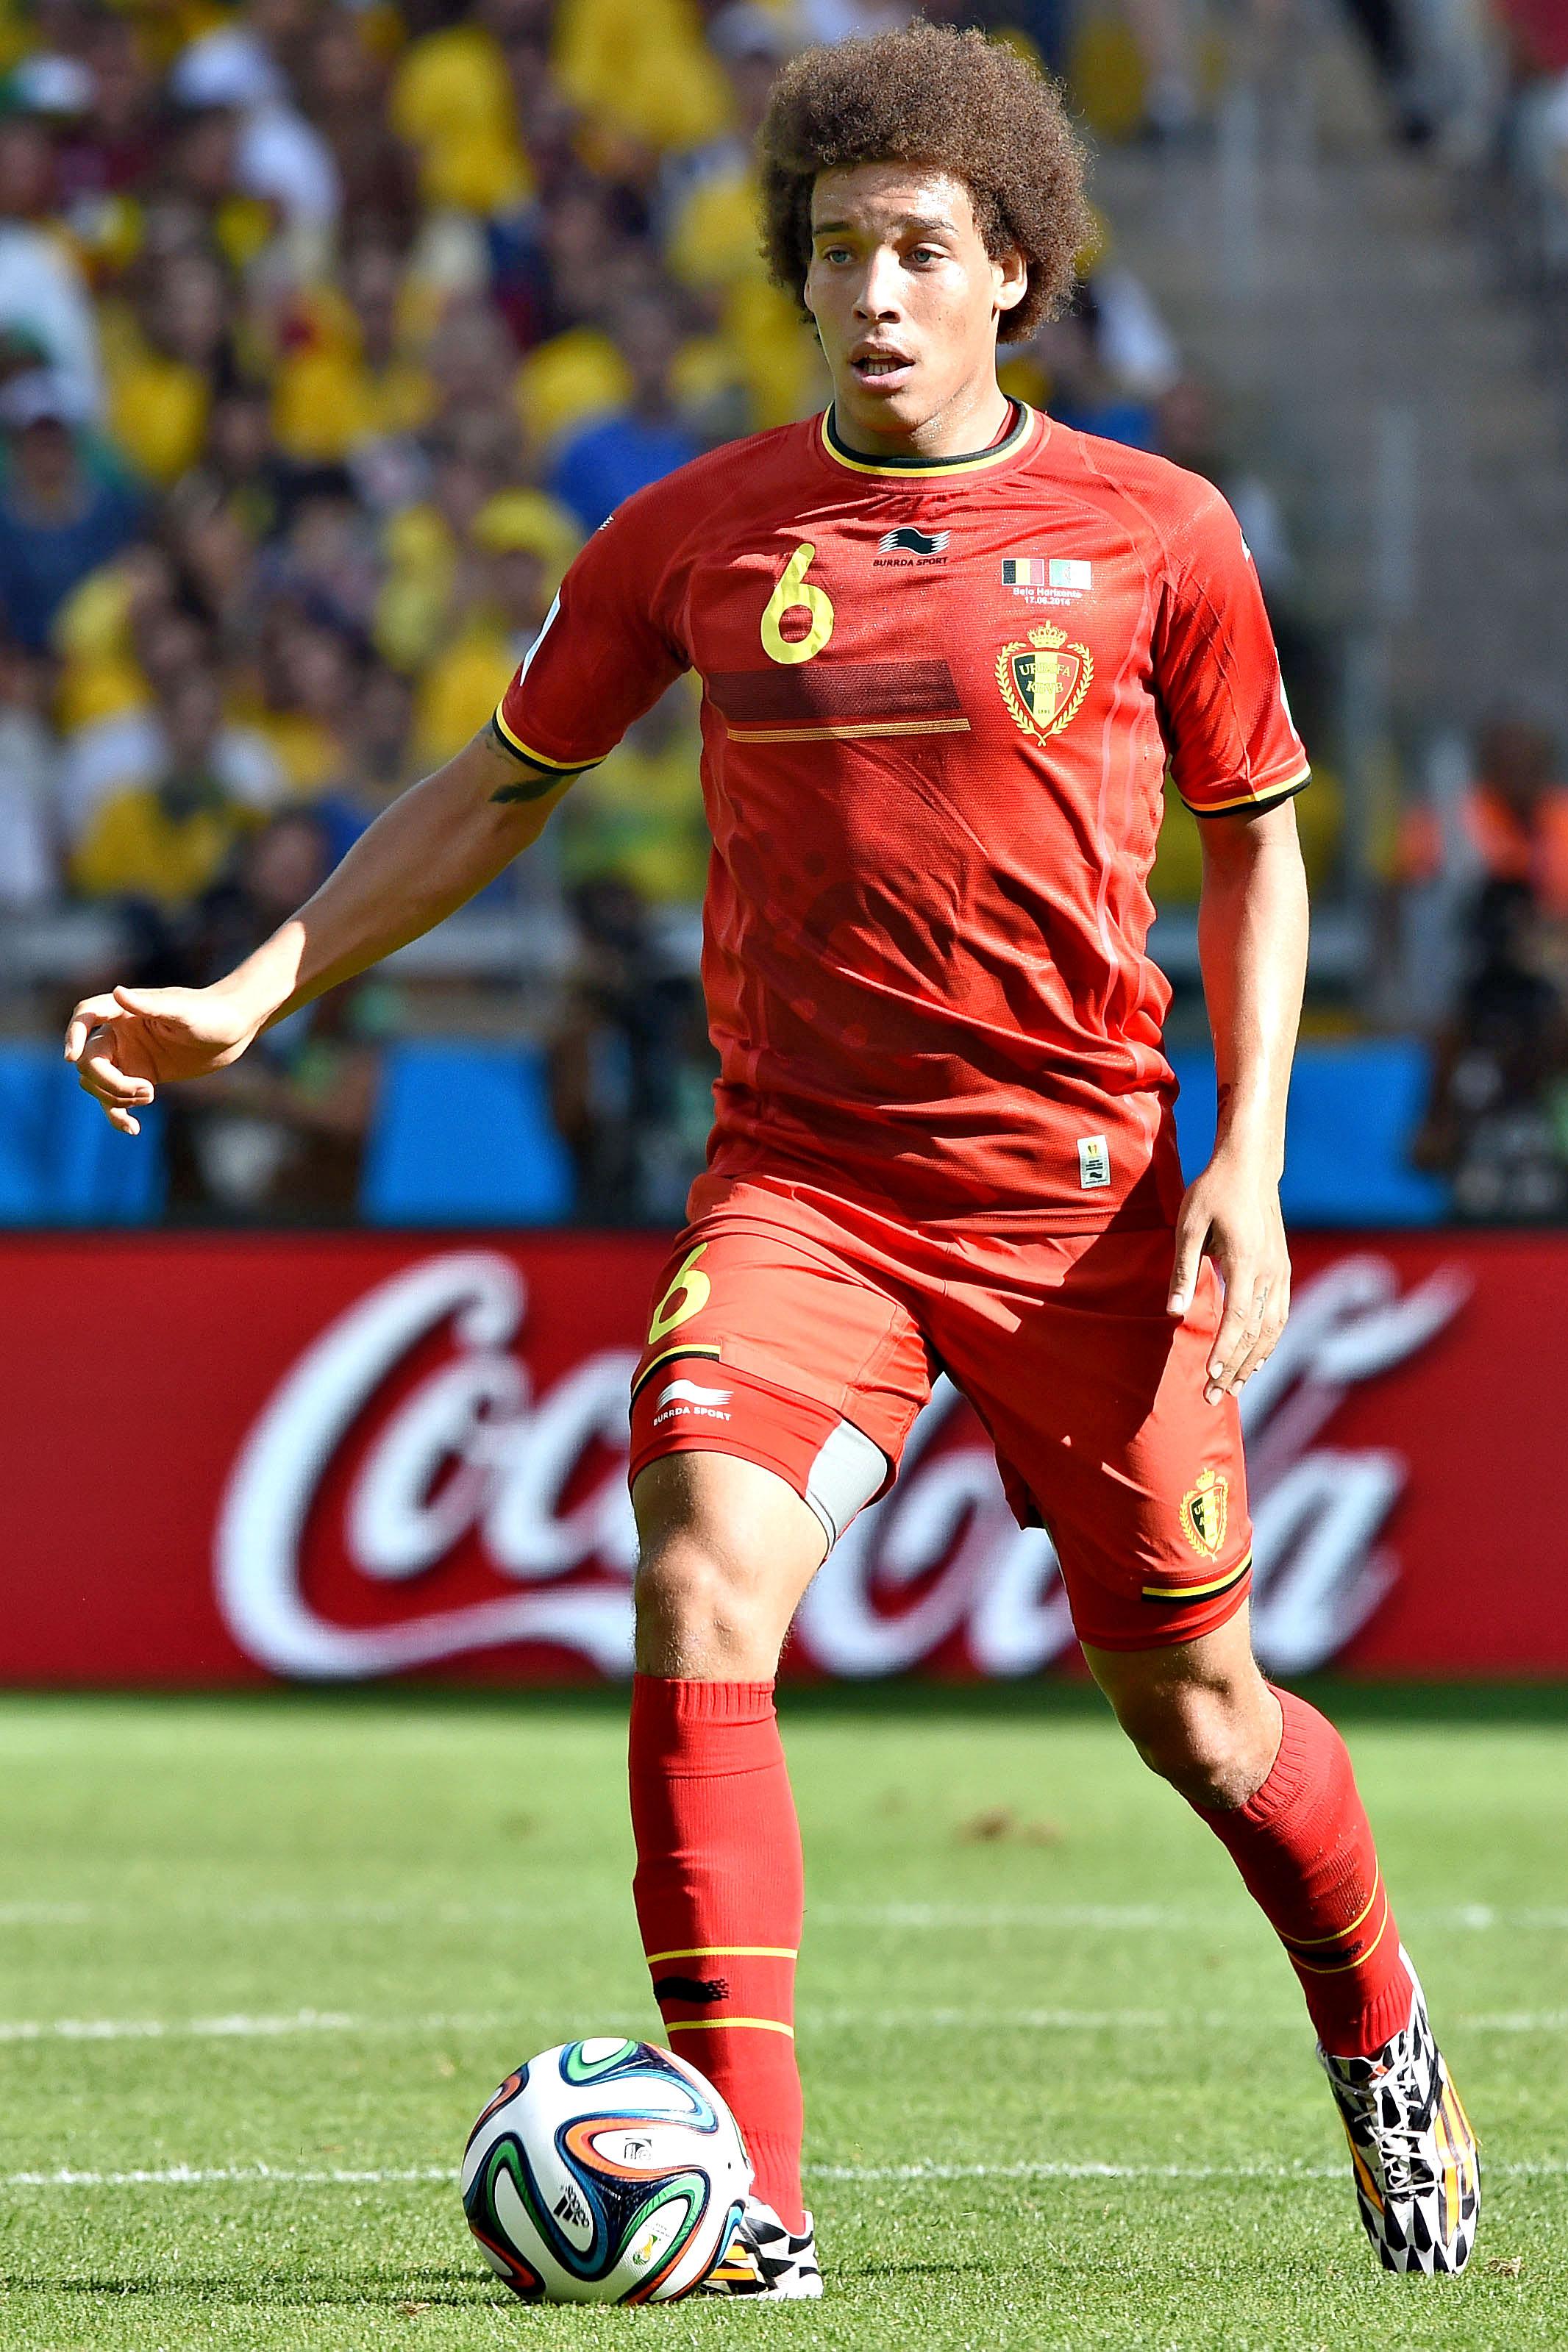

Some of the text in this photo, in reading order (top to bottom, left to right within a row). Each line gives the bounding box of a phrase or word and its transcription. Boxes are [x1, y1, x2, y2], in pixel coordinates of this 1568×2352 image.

[873, 557, 949, 567] BURRDA SPORT
[1013, 587, 1035, 596] Belo
[760, 543, 835, 665] 6
[648, 1242, 712, 1345] 6
[653, 1406, 733, 1426] BURRDA SPORT
